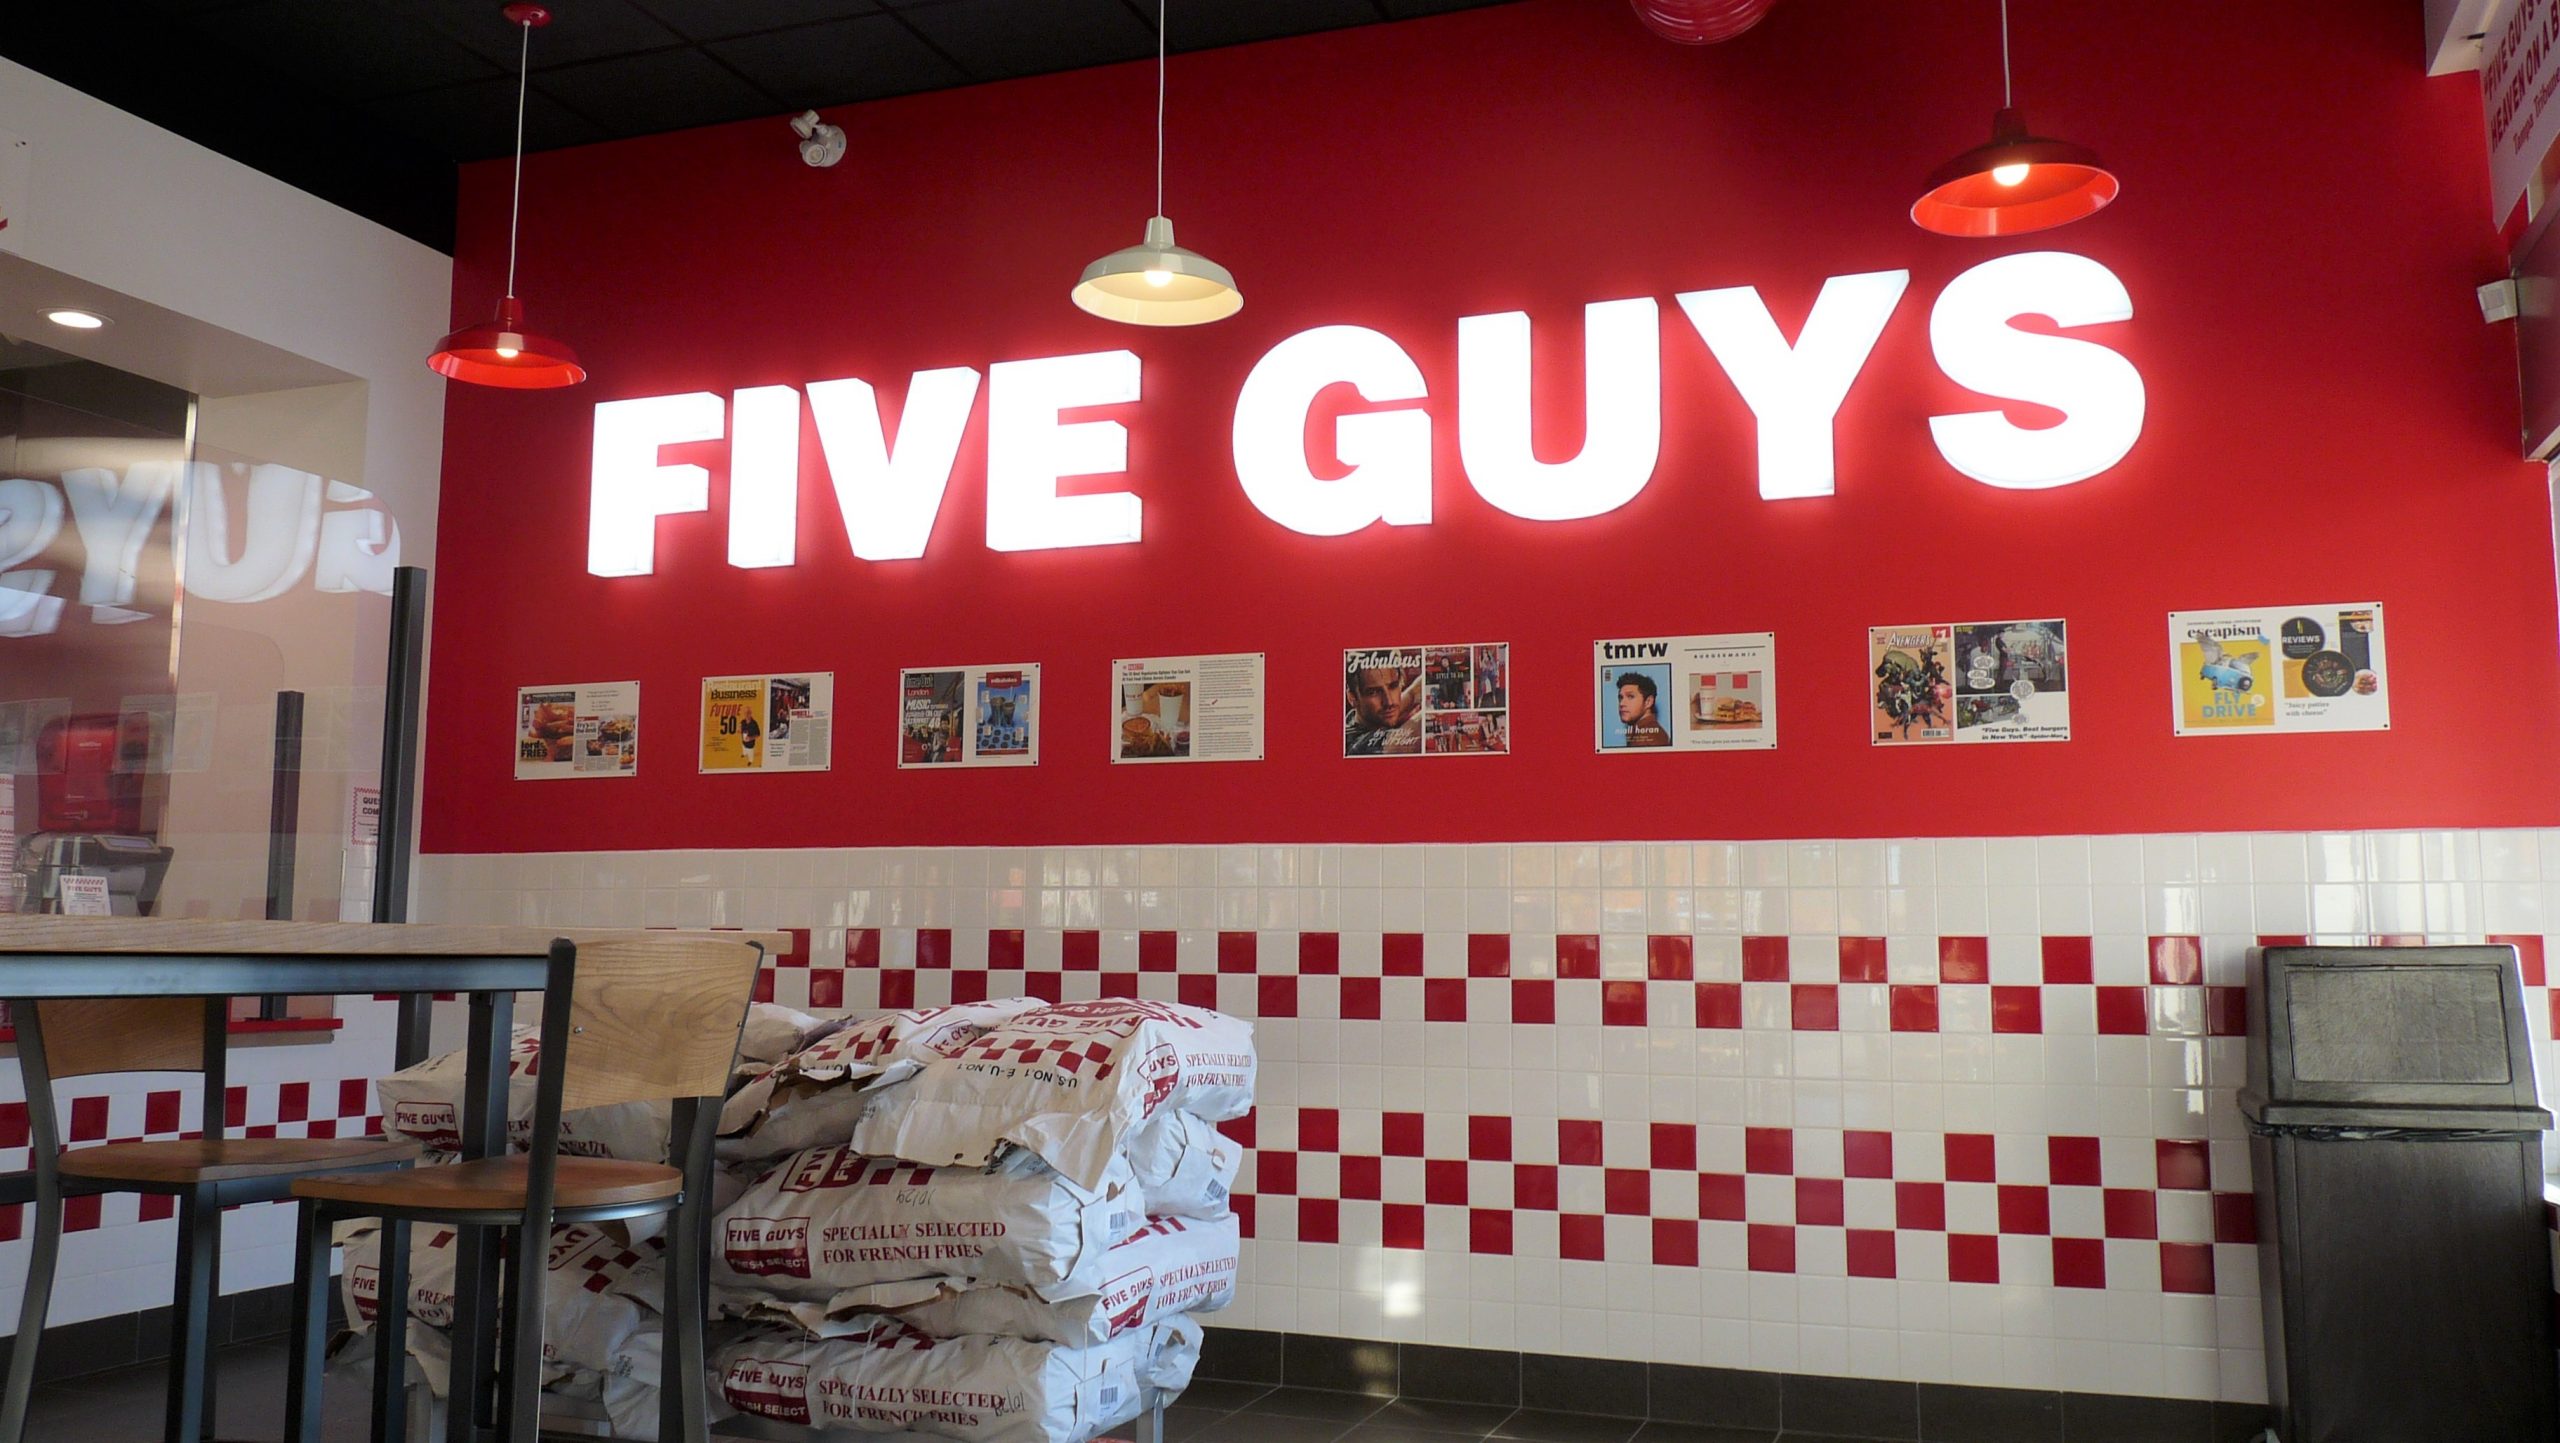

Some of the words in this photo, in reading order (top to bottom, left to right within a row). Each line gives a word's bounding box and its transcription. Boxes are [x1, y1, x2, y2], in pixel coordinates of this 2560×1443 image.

[2491, 63, 2525, 153] HEAVEN
[2526, 35, 2540, 85] ON
[2543, 20, 2550, 59] A
[587, 349, 1142, 578] FIVE
[1232, 251, 2146, 537] GUYS
[2187, 624, 2261, 639] escapism
[2282, 635, 2320, 644] REVIEWS
[1603, 642, 1668, 659] tmrw
[1347, 649, 1422, 673] Fabulous
[711, 689, 757, 700] Business
[2214, 690, 2241, 704] FLY
[710, 703, 742, 717] FUTURE
[2202, 704, 2257, 717] DRIVE
[720, 716, 737, 735] 50
[1635, 725, 1659, 734] horan
[363, 797, 380, 805] QUE
[729, 1228, 760, 1242] FIVE
[765, 1227, 804, 1243] GUYS
[823, 1223, 909, 1243] SPECIALLY
[915, 1222, 1007, 1238] SELECTED
[823, 1249, 856, 1264] FOR
[860, 1244, 930, 1262] FRENCH
[935, 1244, 983, 1259] FRIES
[353, 1277, 376, 1291] FIVE
[1102, 1289, 1129, 1311] FIVE
[1156, 1293, 1177, 1310] FOR
[730, 1369, 763, 1384] FIVE
[818, 1379, 909, 1404] SPECIALLY
[912, 1387, 1005, 1409] SELECTED
[763, 1402, 806, 1417] SELECT
[823, 1399, 853, 1419] FOR
[857, 1405, 926, 1425] FRENCH
[928, 1409, 980, 1428] FRIES
